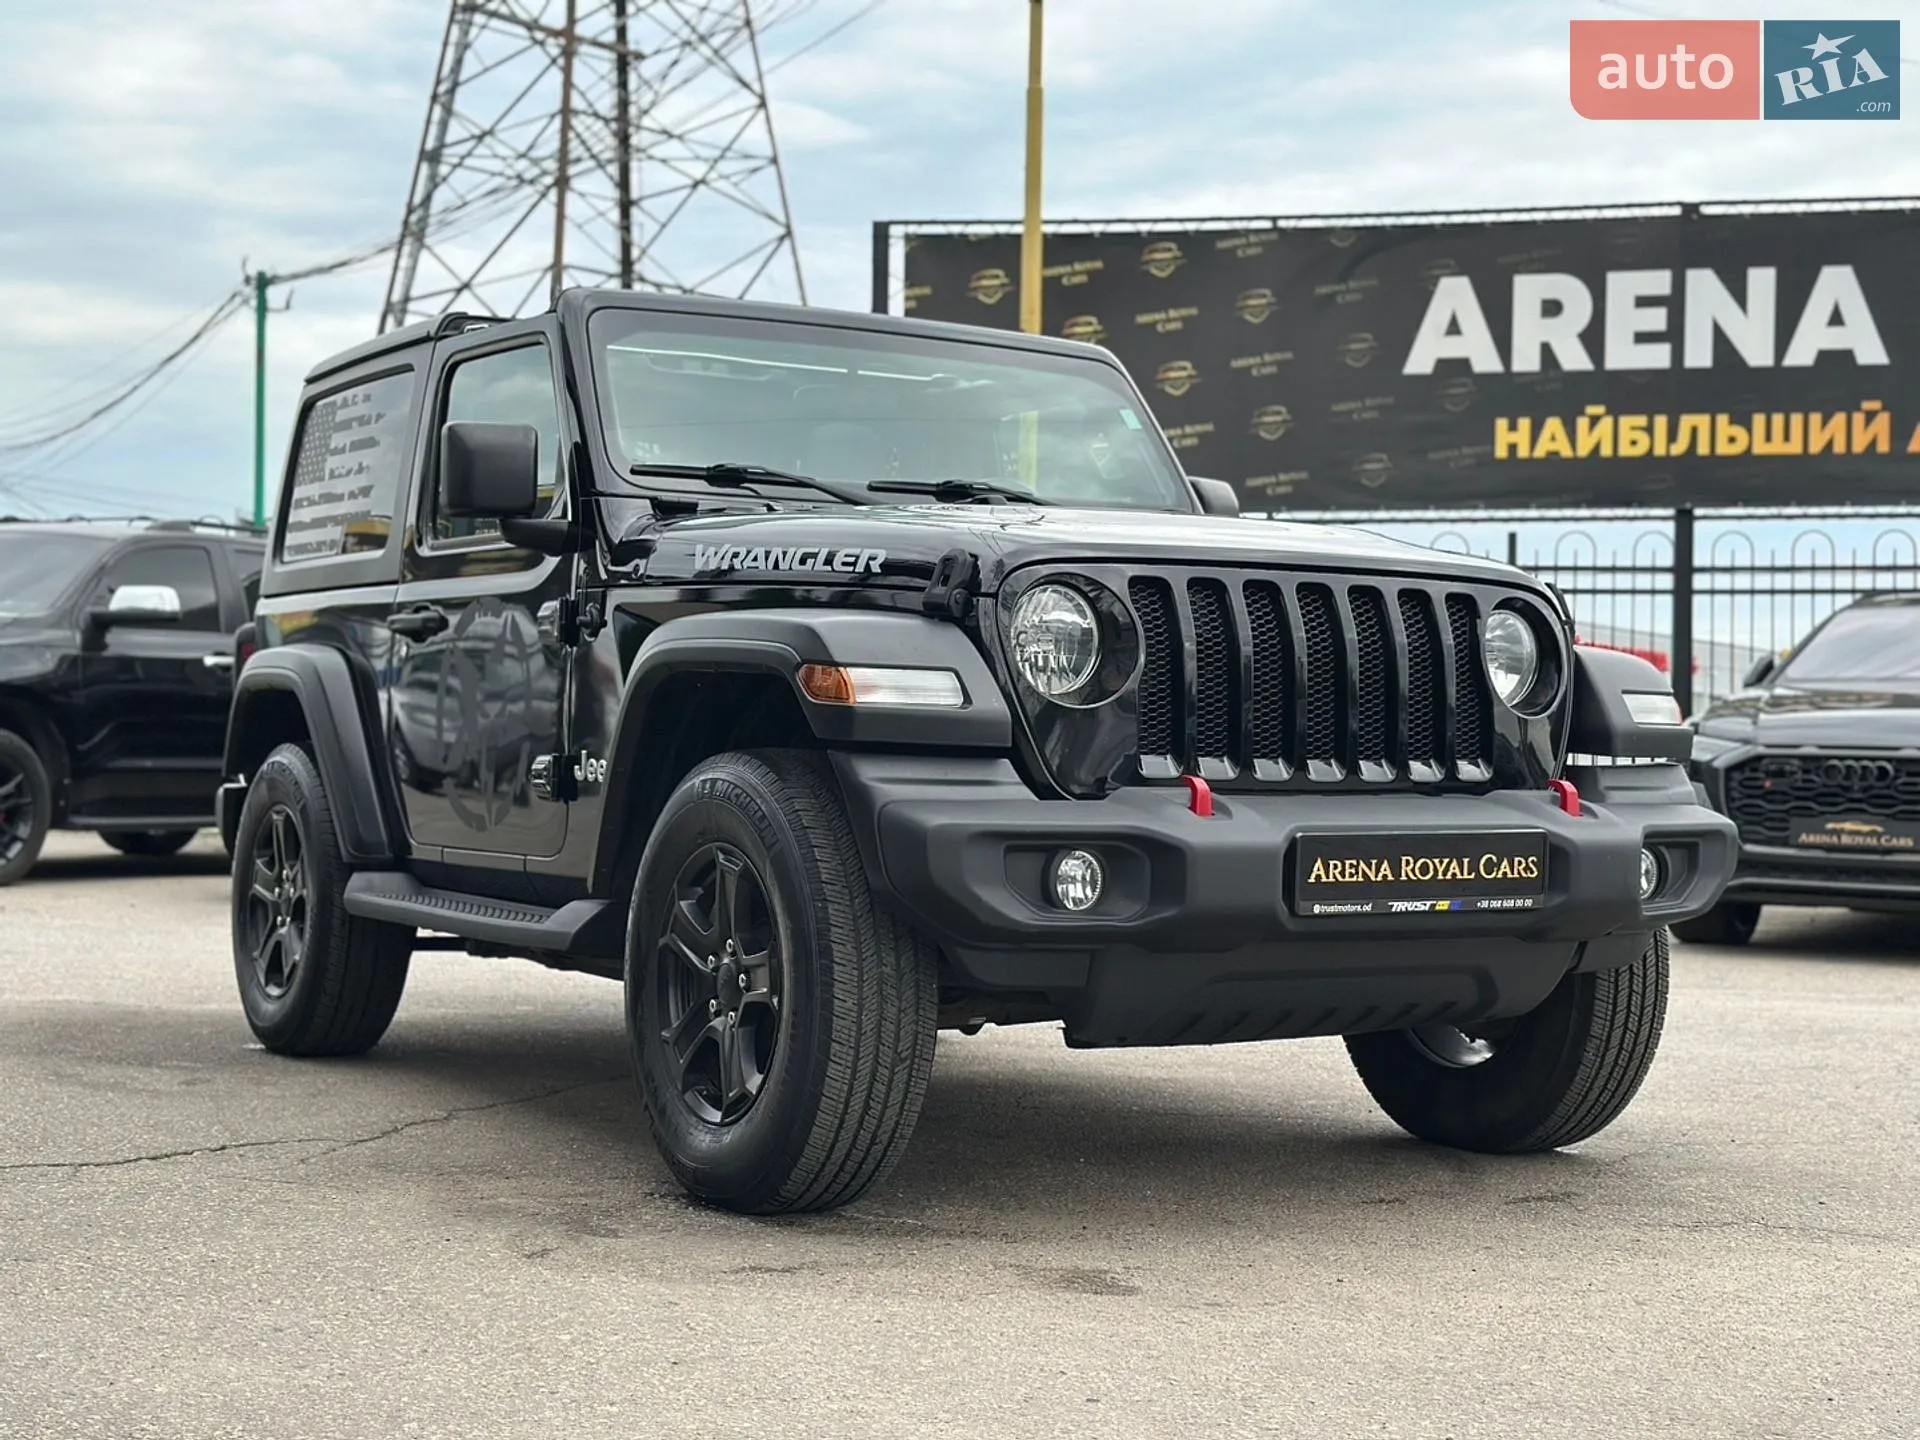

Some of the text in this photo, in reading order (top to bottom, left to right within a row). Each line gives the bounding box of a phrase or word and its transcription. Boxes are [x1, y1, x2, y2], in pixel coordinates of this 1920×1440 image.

[1402, 265, 1890, 375] ARENA
[1494, 400, 1890, 460] НАЙБІЛЬШИЙ
[694, 543, 888, 574] WRANGLER
[574, 750, 607, 782] Jee
[1307, 854, 1539, 883] ARENA ROYAL CARS
[1387, 901, 1436, 912] TRUST
